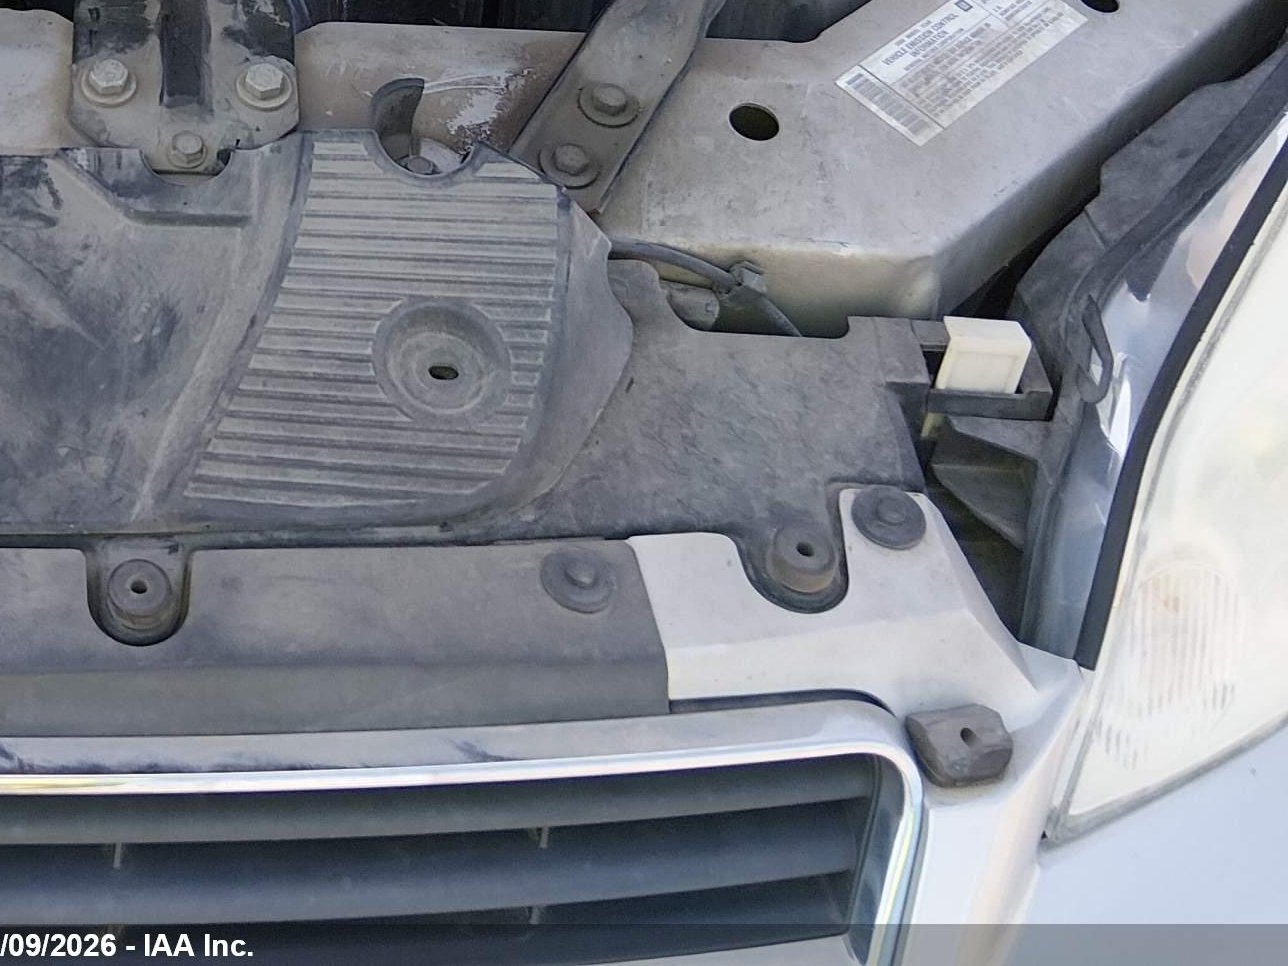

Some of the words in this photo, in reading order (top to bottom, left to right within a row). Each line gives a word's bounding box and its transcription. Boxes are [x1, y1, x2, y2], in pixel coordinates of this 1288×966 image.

[882, 46, 908, 65] VEHICLE
[905, 30, 934, 49] EMISSION
[931, 12, 960, 32] CONTROL
[910, 29, 950, 58] INFORMATION
